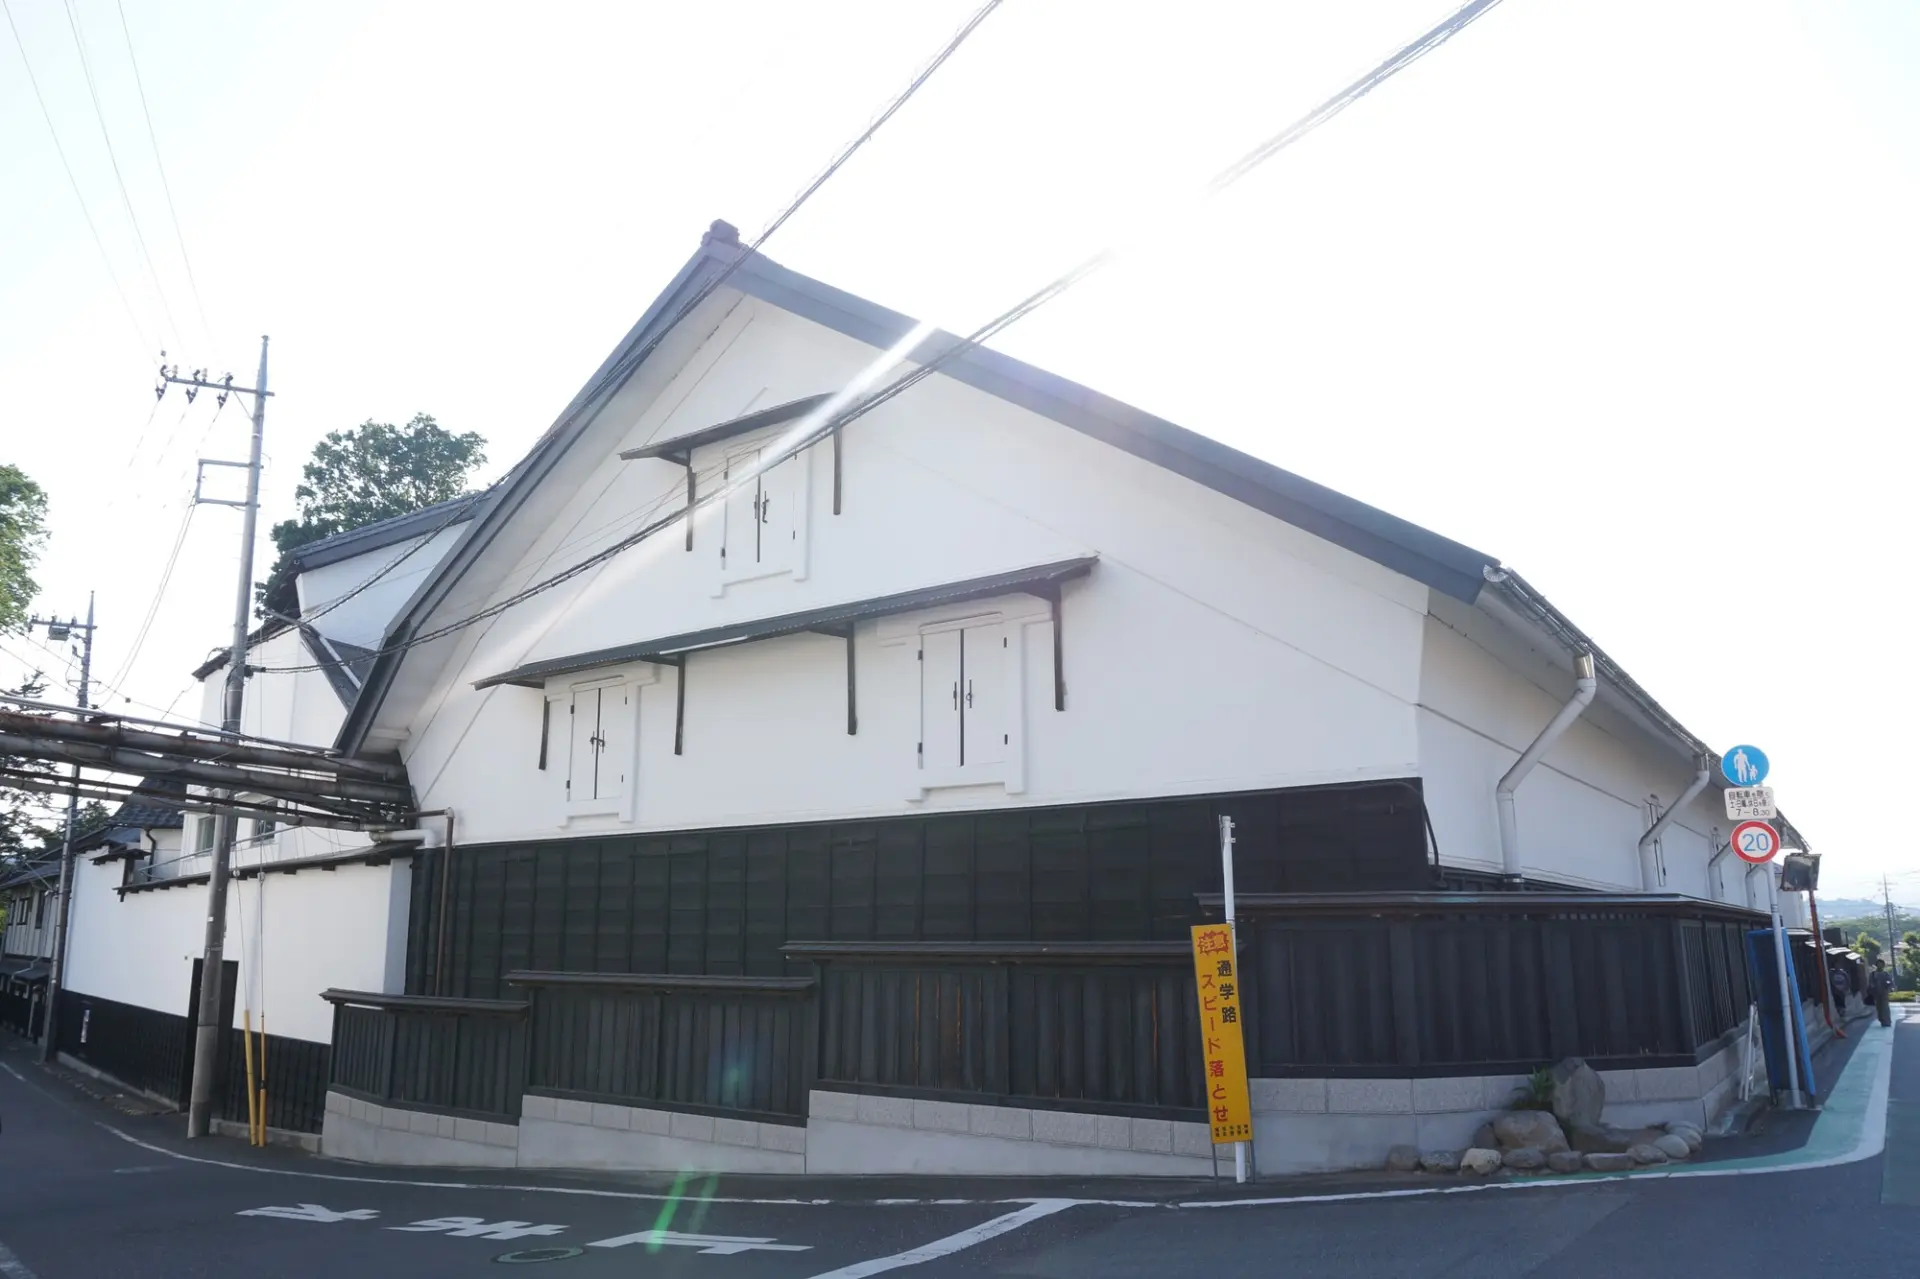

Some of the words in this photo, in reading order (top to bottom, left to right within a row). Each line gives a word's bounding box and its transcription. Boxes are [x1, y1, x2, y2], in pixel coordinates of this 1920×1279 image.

[1742, 833, 1769, 852] 20
[1217, 960, 1237, 1023] 通学路
[1202, 974, 1228, 1122] スピード落とせ
